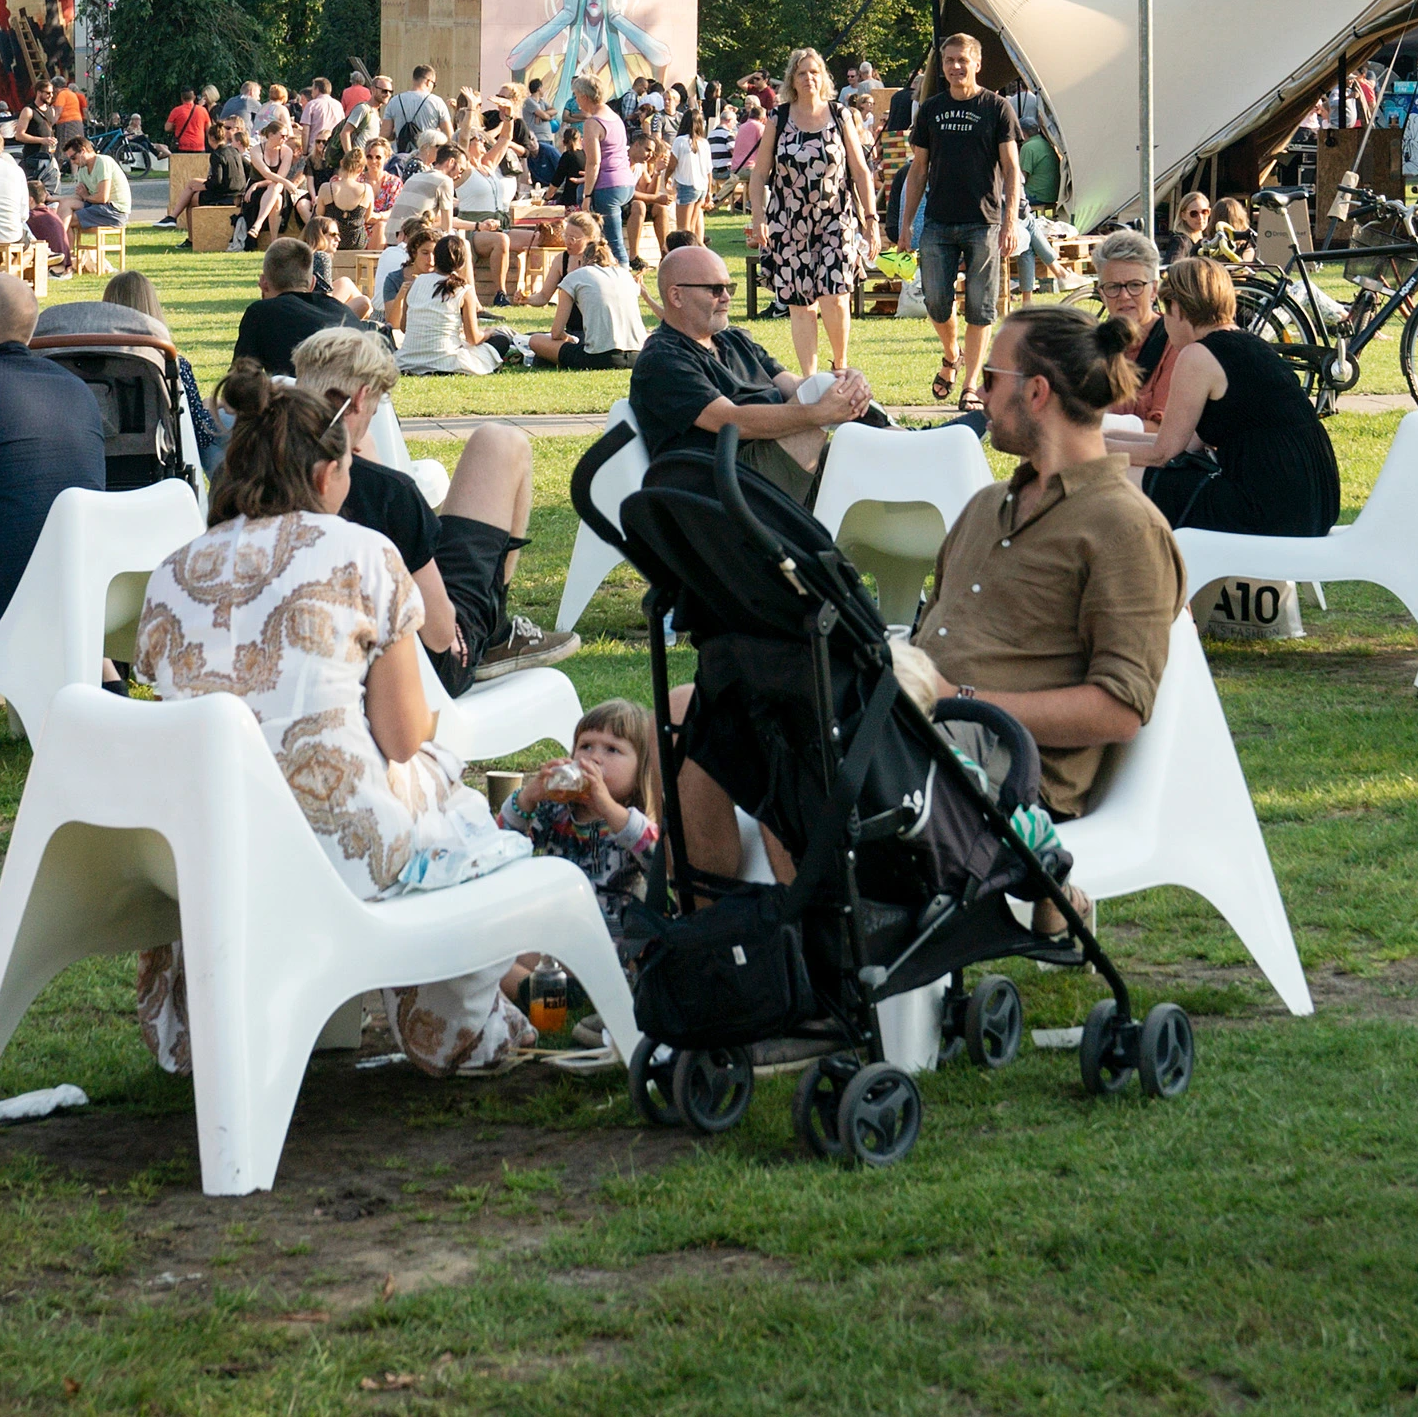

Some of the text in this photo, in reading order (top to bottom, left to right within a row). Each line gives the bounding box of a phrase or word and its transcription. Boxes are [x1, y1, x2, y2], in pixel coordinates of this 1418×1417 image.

[935, 110, 965, 122] SIGNAL
[940, 123, 973, 131] NINETEEN
[1213, 581, 1280, 624] A10
[1230, 626, 1280, 639] FASHION
